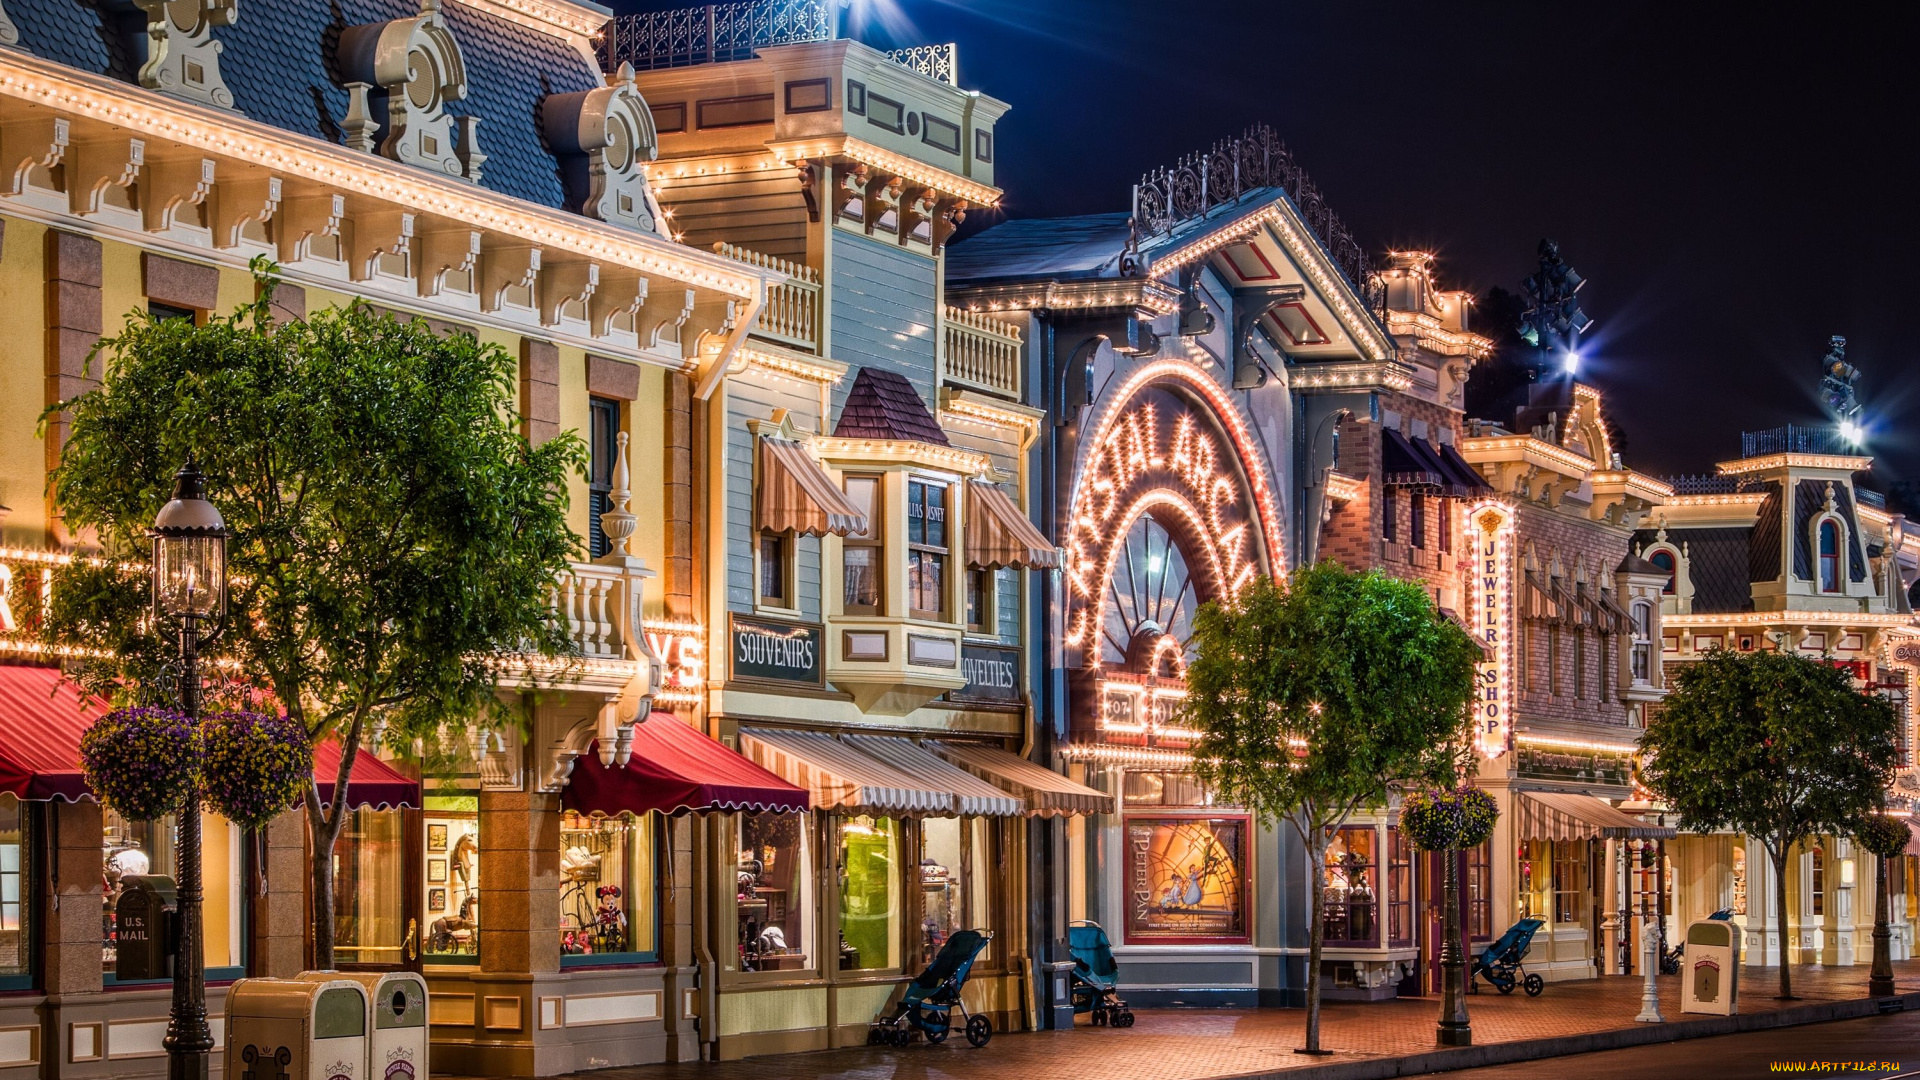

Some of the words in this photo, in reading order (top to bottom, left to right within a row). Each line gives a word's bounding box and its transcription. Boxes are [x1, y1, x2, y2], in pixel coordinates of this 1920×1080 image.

[738, 632, 814, 670] SOUVENIRS
[1893, 646, 1920, 661] CAR
[1486, 669, 1499, 734] SHOP
[1133, 838, 1151, 889] PETER
[125, 917, 145, 927] U.S.
[1135, 889, 1152, 922] PAN
[120, 931, 149, 940] MAIL
